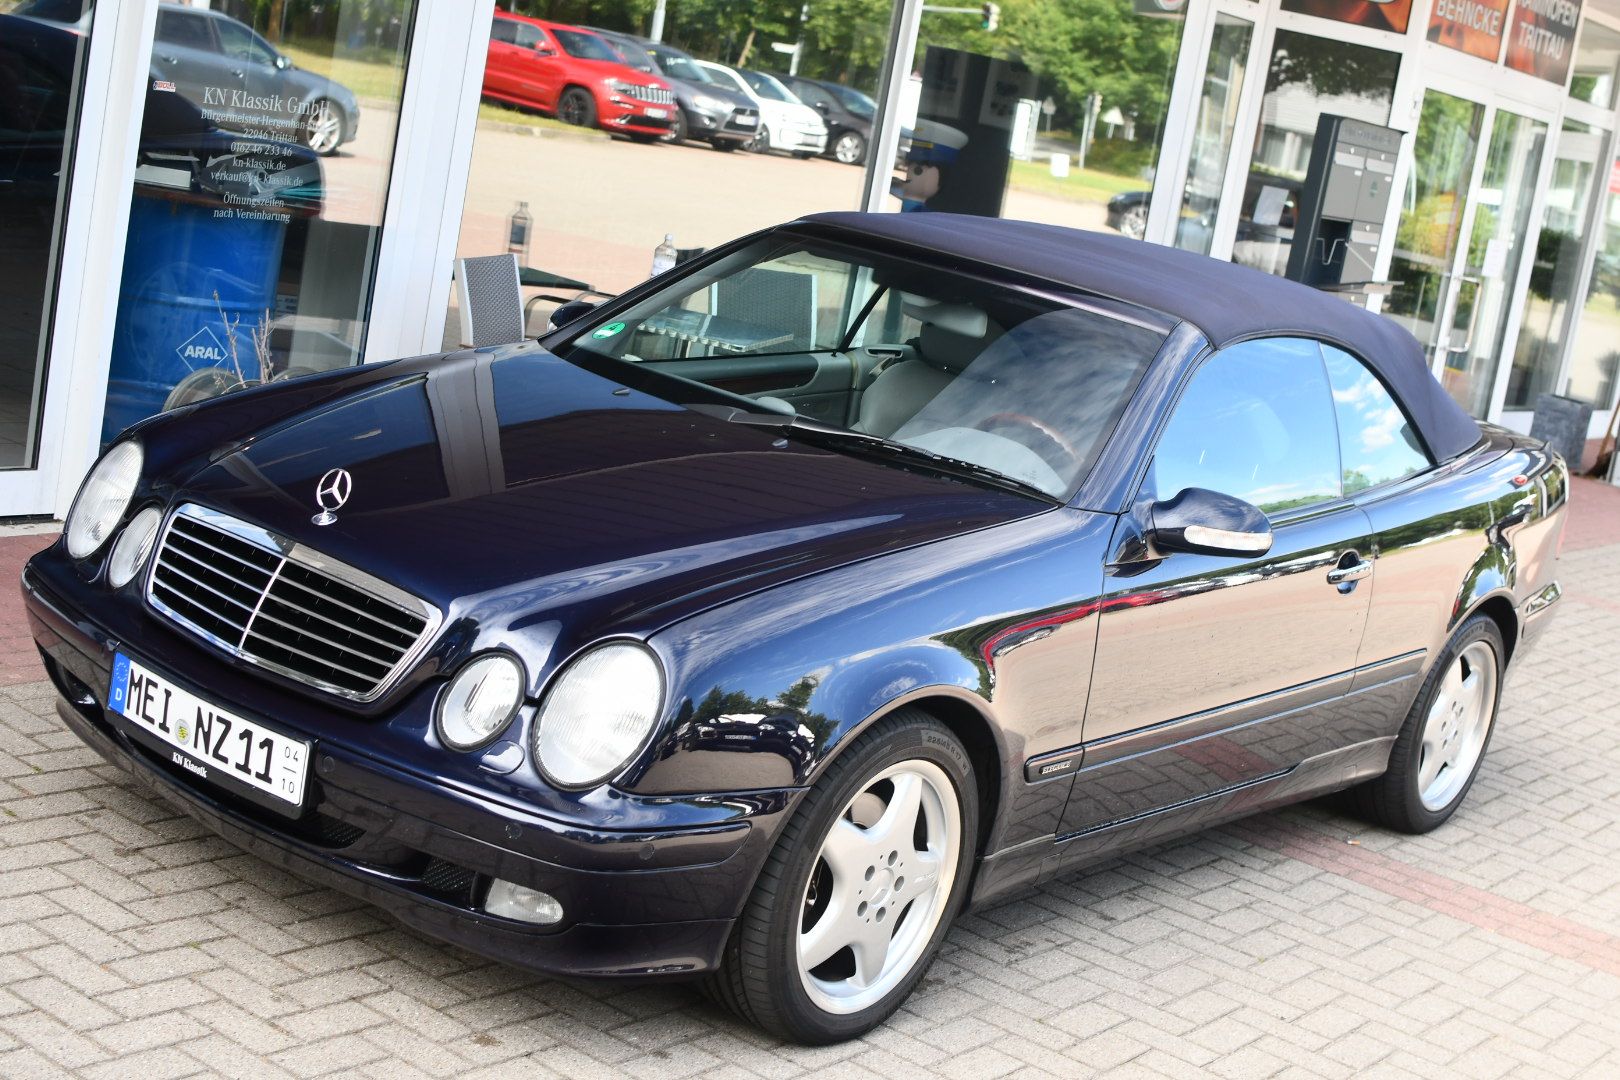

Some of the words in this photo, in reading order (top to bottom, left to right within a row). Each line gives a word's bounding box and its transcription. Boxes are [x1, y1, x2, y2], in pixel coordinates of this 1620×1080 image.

[1436, 0, 1502, 37] BEHNCKE
[1518, 21, 1566, 61] TRITTAU
[203, 87, 228, 106] KN
[231, 89, 283, 112] Klassik
[287, 96, 330, 118] GmbH
[243, 128, 268, 140] 22946
[271, 130, 298, 143] Trittau
[230, 142, 249, 153] 0162
[264, 145, 280, 155] 233
[282, 147, 293, 157] 46
[233, 157, 286, 171] kn-klassik.de
[223, 191, 284, 208] Öffnungszeiten
[213, 208, 233, 218] nach
[236, 209, 291, 223] Vereinbarung
[184, 344, 222, 361] ARAL
[115, 687, 123, 701] D
[126, 668, 172, 735] MEI
[284, 746, 299, 763] 04
[281, 778, 295, 794] 10
